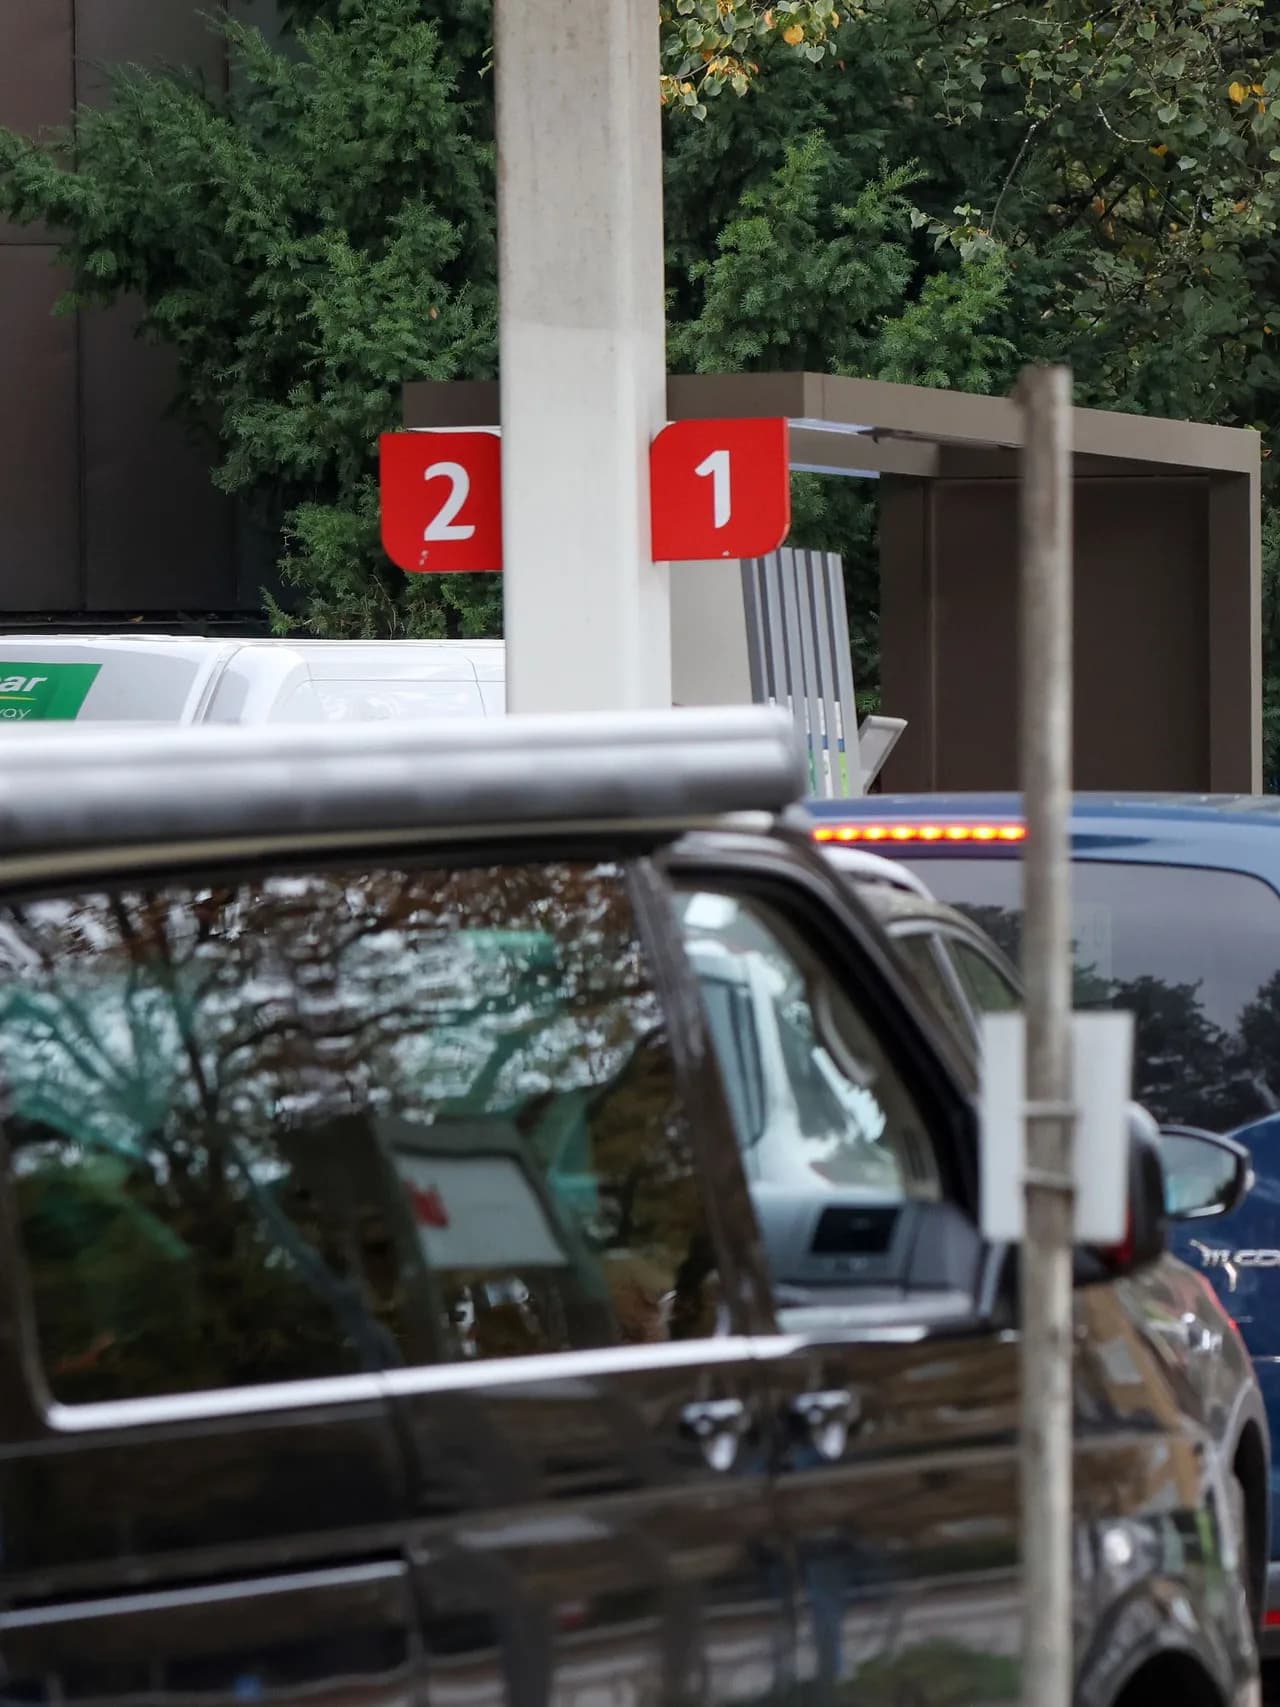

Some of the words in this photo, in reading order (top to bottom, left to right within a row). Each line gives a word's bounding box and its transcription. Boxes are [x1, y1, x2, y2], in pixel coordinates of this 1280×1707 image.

[424, 461, 475, 541] 2
[694, 449, 731, 529] 1
[0, 676, 48, 692] ar
[0, 708, 32, 720] ay
